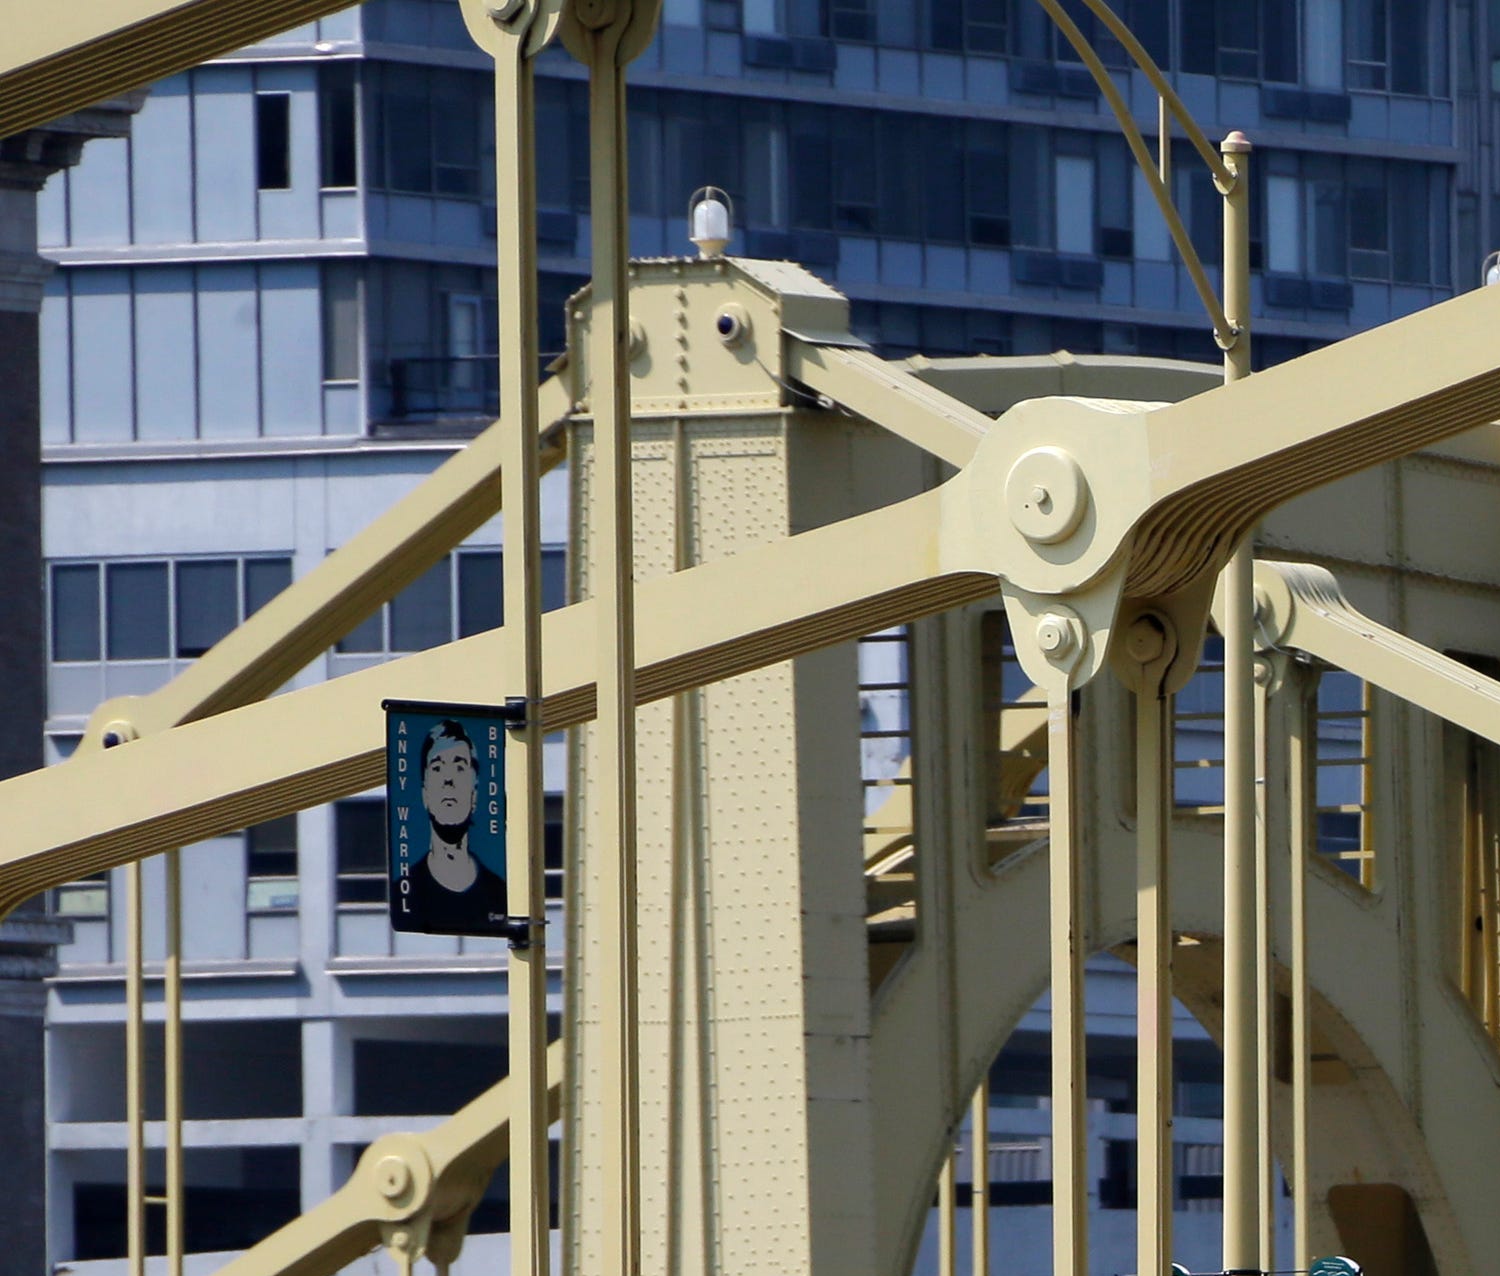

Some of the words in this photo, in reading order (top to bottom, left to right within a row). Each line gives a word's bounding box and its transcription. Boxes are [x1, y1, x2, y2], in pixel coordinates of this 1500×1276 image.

[397, 720, 407, 791] ANDY
[488, 726, 498, 834] BRIDGE
[397, 806, 410, 913] WARHOL
